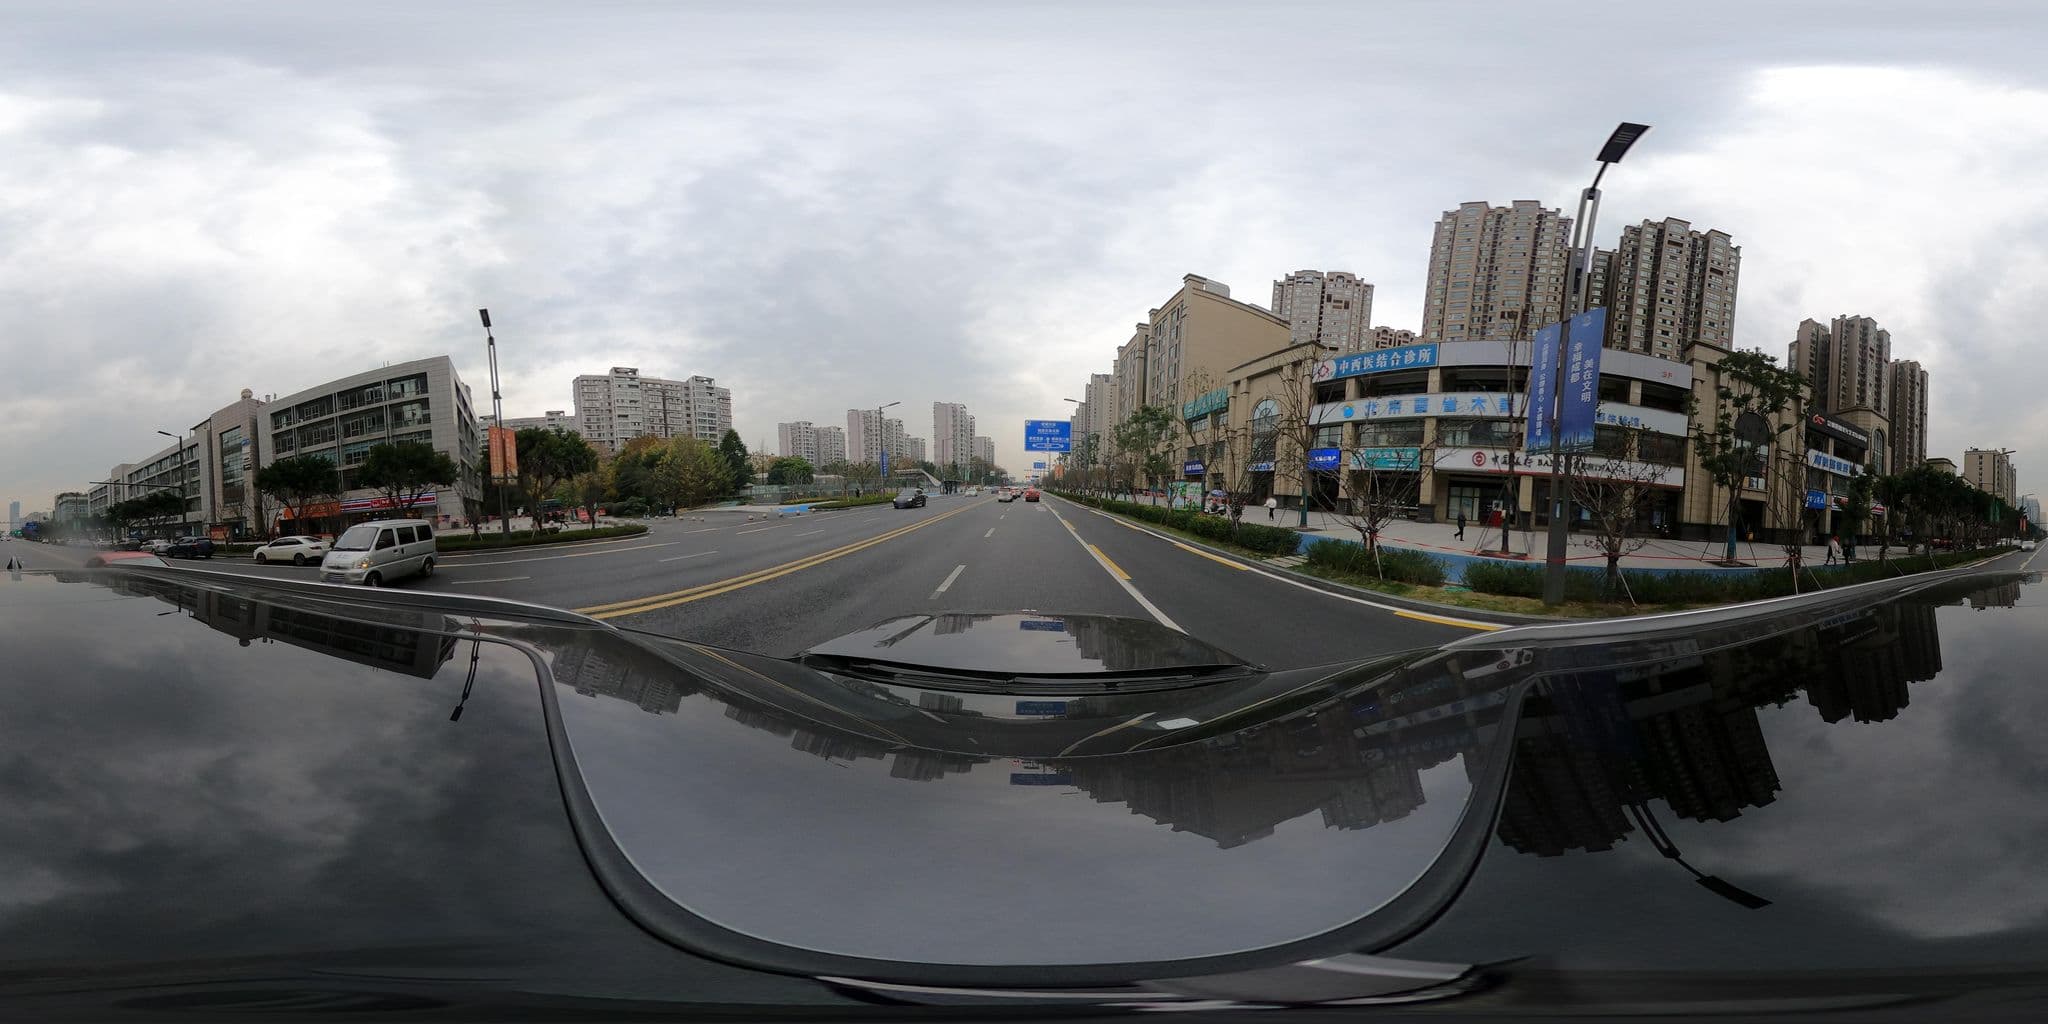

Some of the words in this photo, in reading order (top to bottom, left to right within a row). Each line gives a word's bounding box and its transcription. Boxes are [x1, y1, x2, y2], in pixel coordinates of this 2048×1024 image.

[1339, 348, 1432, 373] 中西医结合诊所
[1581, 359, 1595, 402] 美在文明
